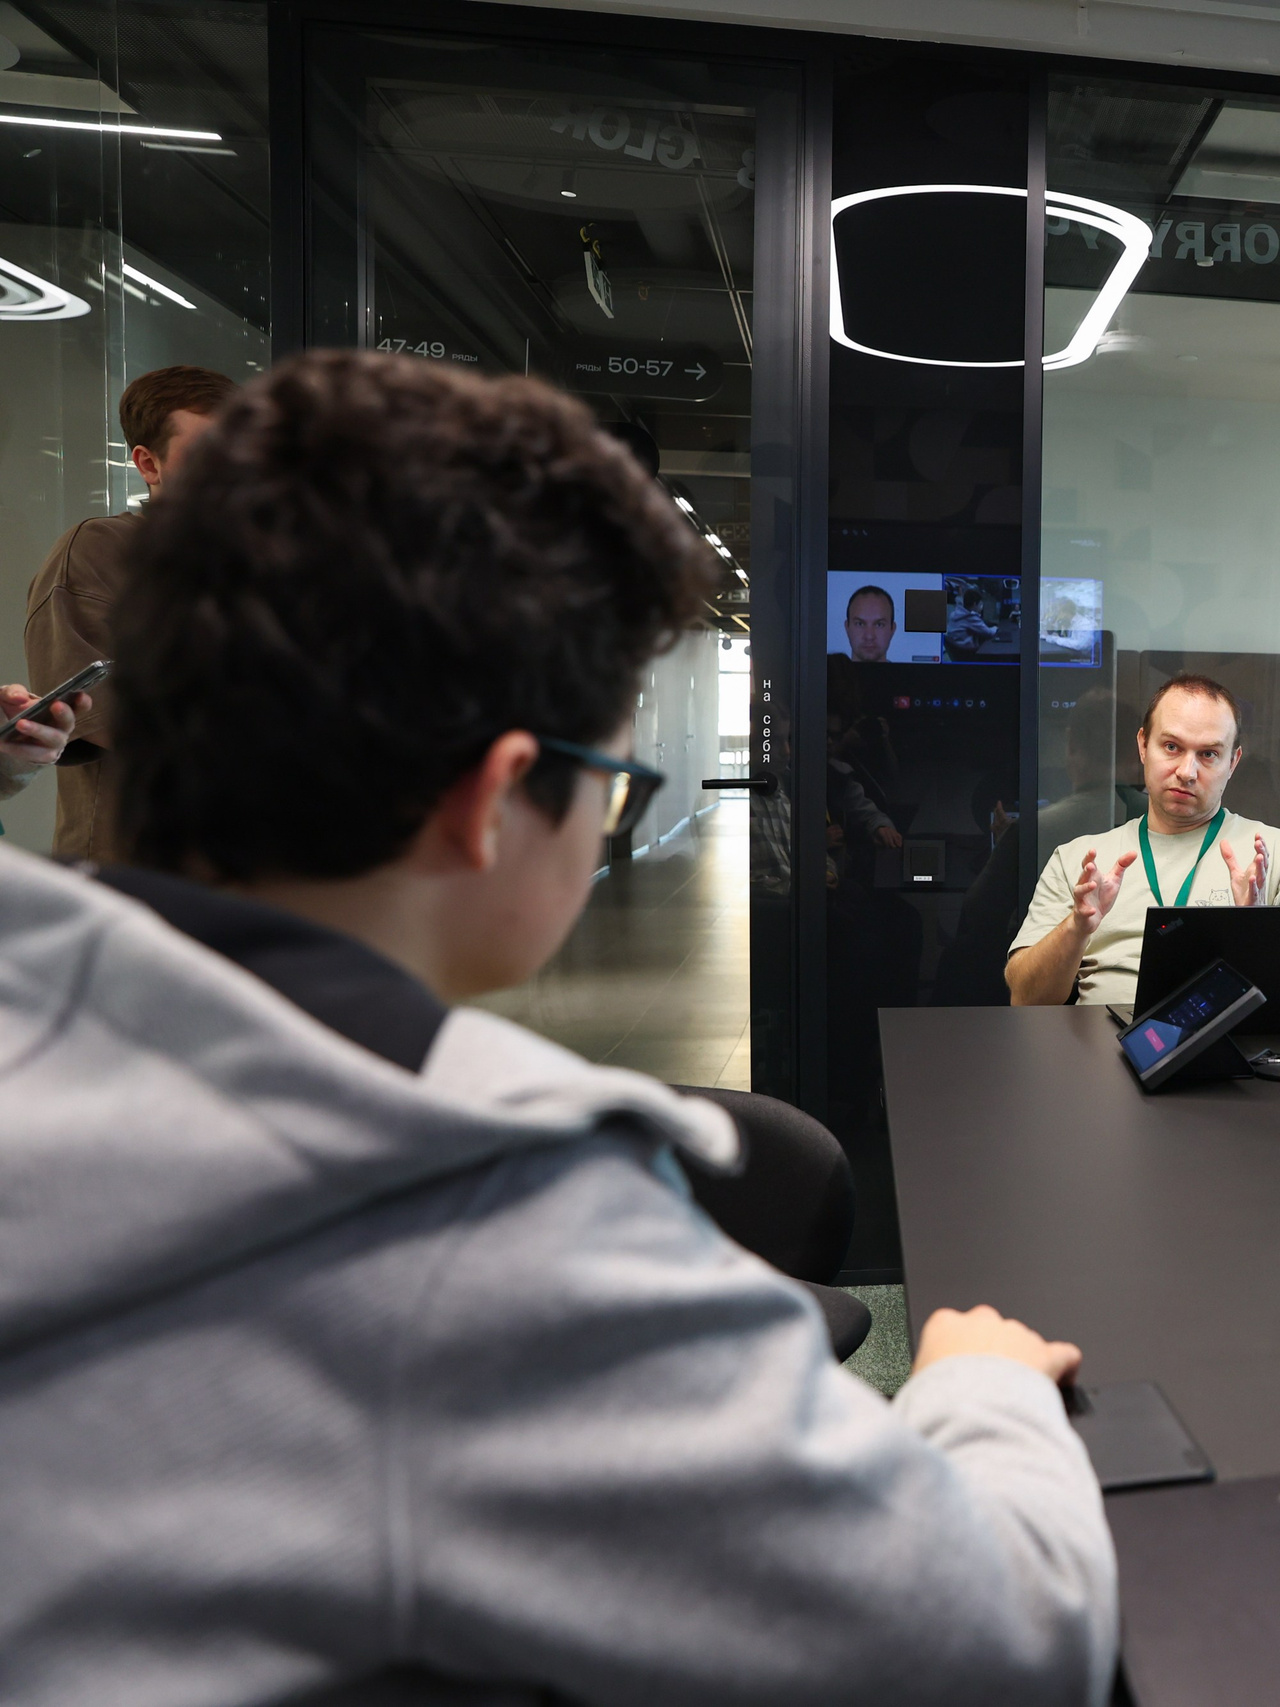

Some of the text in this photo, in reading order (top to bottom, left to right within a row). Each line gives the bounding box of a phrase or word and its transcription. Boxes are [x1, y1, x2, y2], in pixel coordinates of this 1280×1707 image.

[376, 338, 446, 359] 47-49
[608, 356, 674, 377] 50-57
[762, 679, 771, 763] на себя
